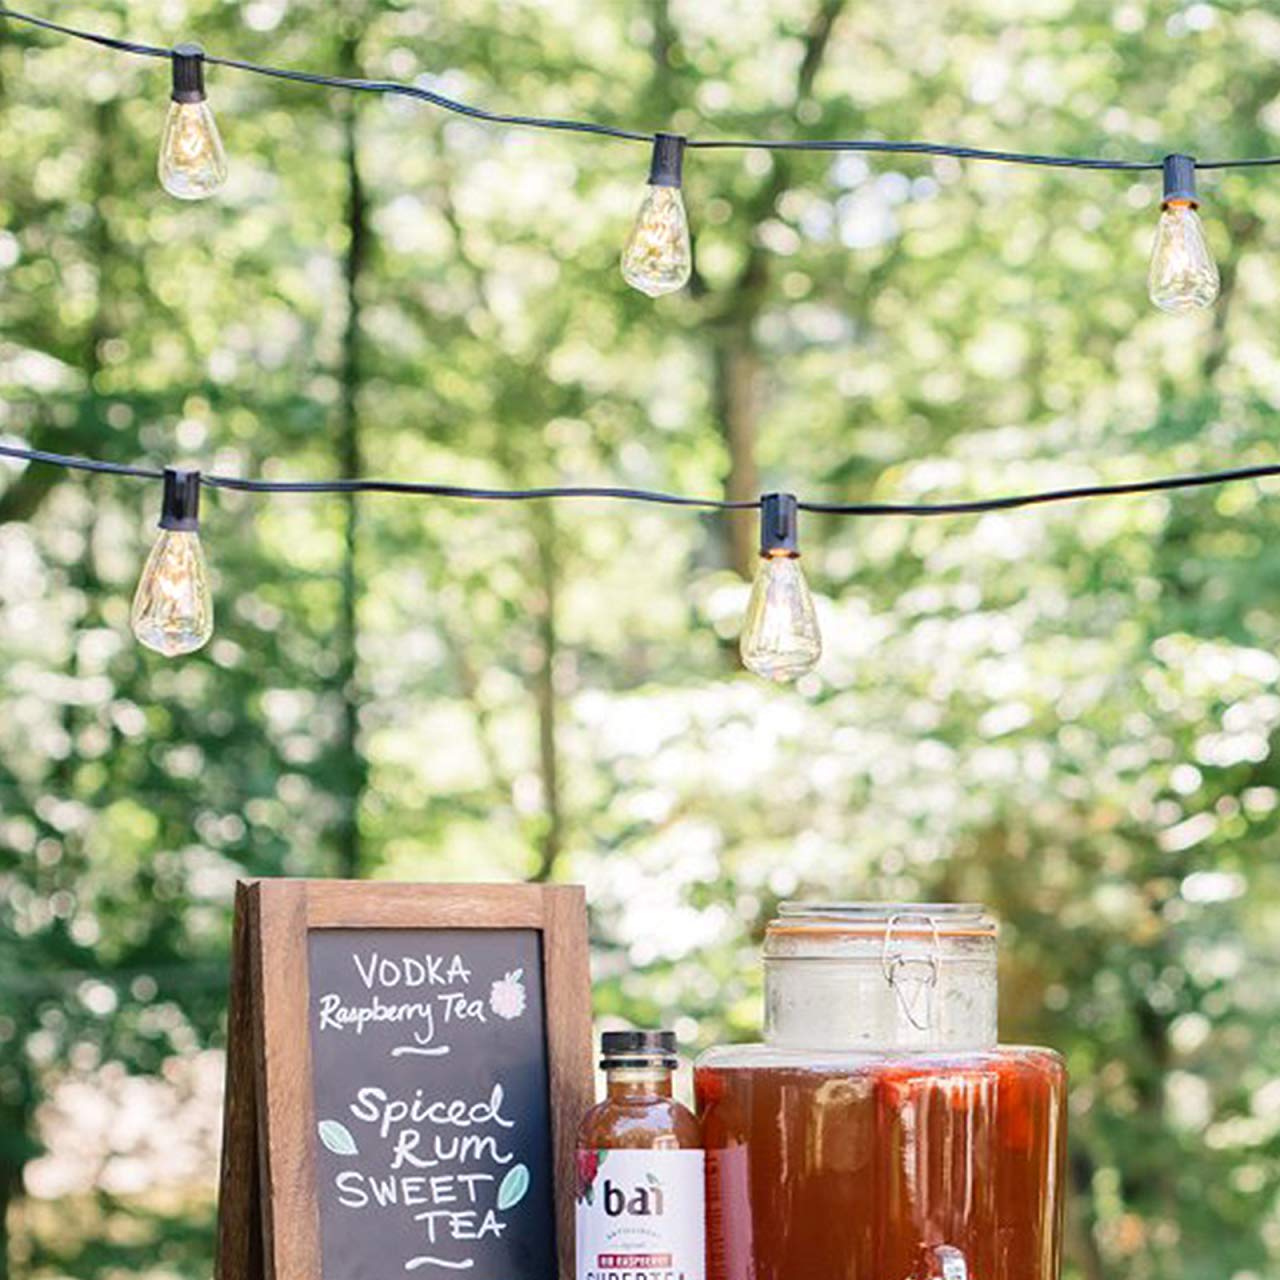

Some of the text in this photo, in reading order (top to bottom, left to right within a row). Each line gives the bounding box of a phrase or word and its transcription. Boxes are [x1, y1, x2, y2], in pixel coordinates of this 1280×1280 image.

[353, 953, 471, 989] VODKA
[319, 992, 487, 1044] Raspberry Tea
[350, 1083, 515, 1138] Spiced
[391, 1129, 514, 1169] Rum
[335, 1171, 494, 1208] SWEET
[603, 1174, 664, 1217] bai
[414, 1210, 506, 1243] TEA
